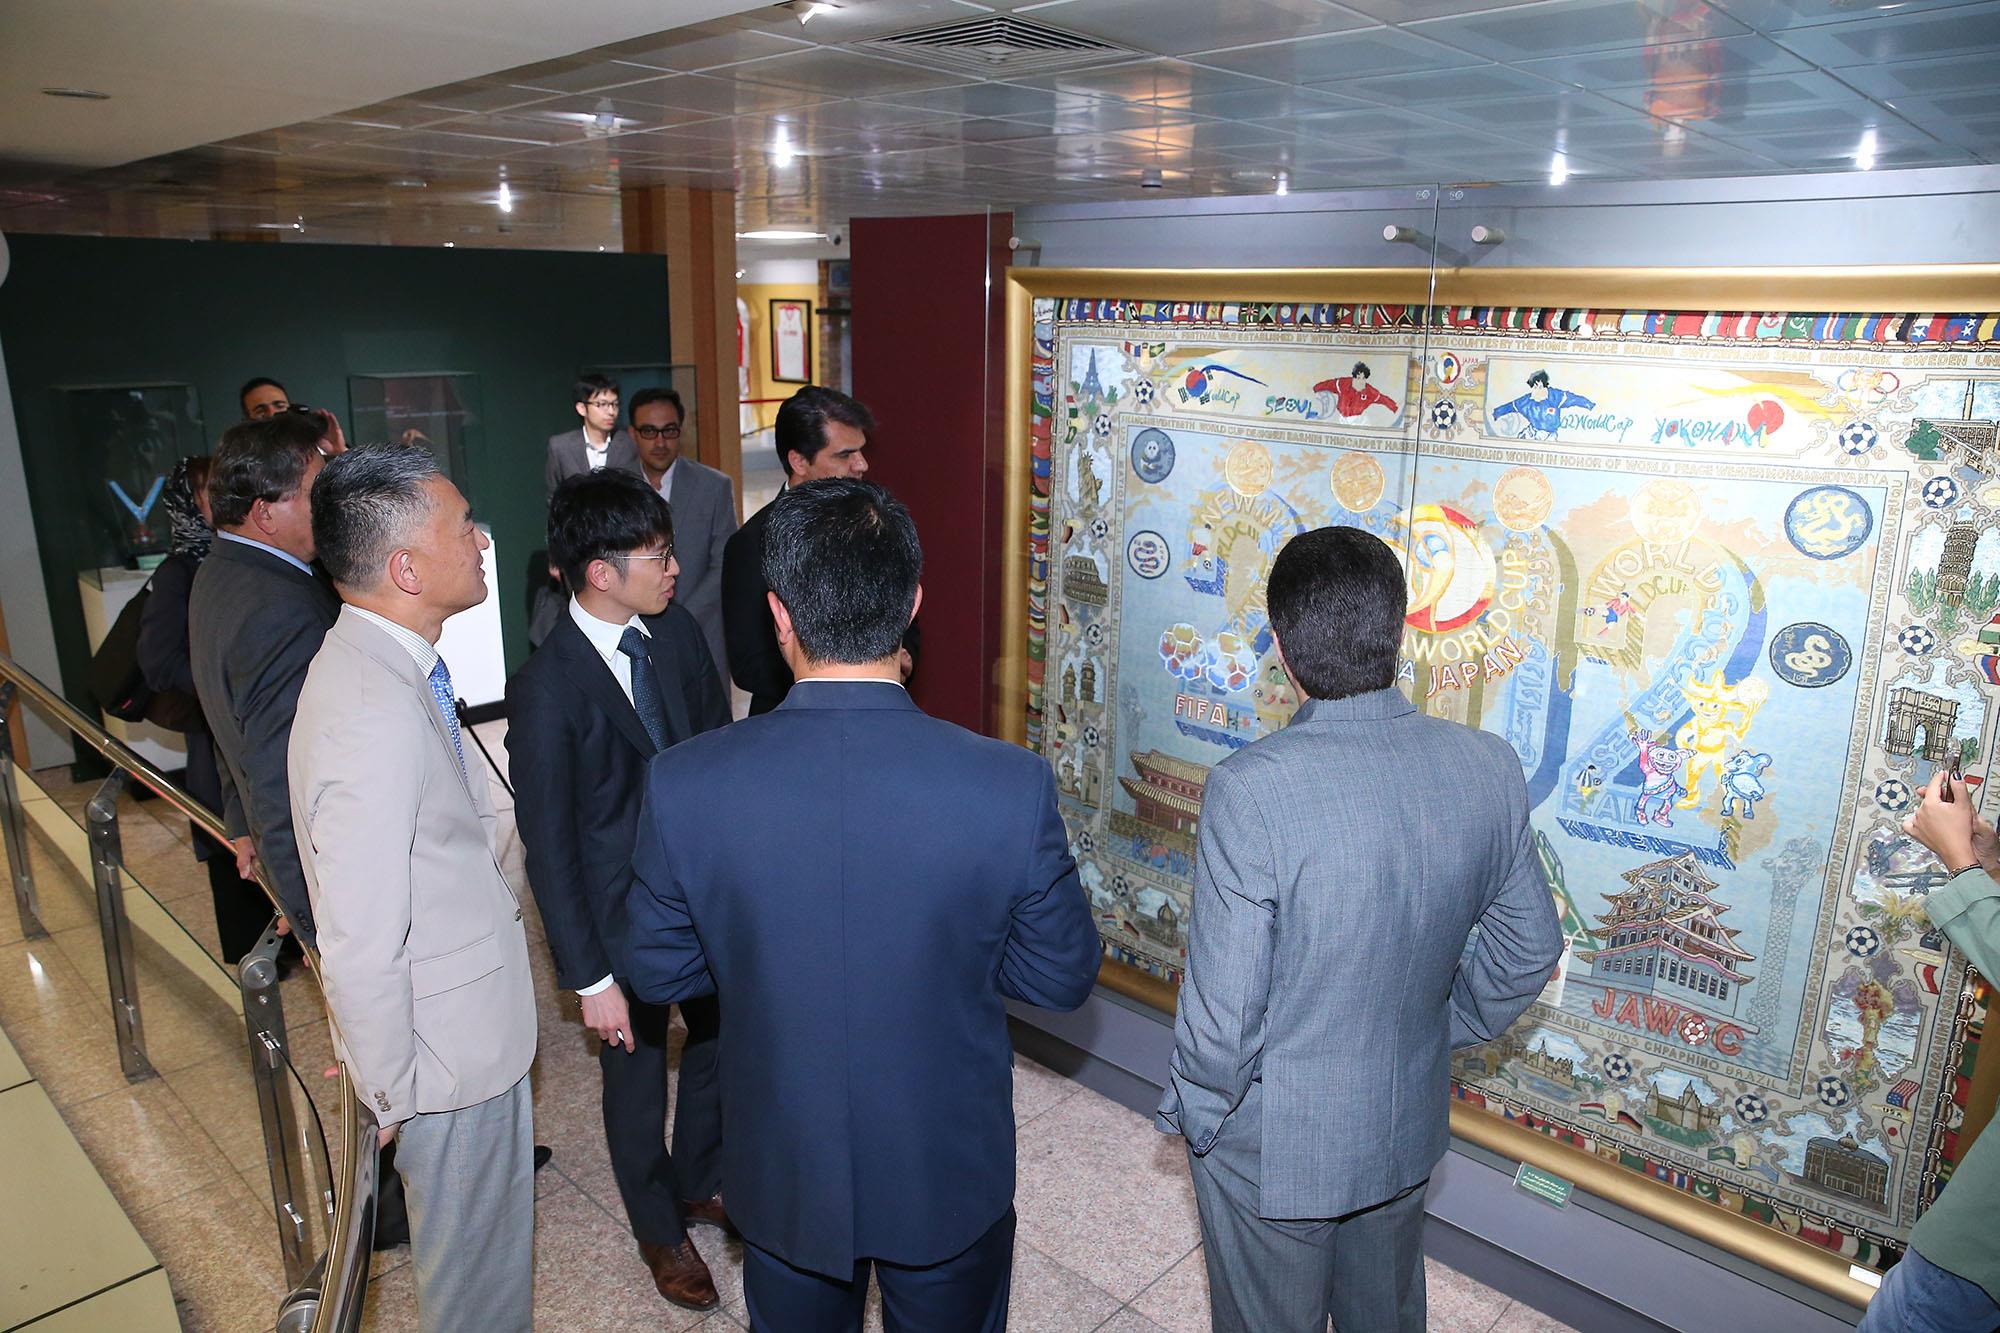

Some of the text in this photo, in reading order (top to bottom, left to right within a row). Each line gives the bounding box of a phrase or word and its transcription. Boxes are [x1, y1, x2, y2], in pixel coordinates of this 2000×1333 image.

[1902, 354, 1968, 366] SWEDEN
[1265, 395, 1319, 420] SEOUL
[1604, 459, 1621, 470] OF
[1425, 636, 1525, 699] JAPAN
[1174, 693, 1229, 729] FIFA
[1591, 987, 1745, 1057] JAWOC
[1596, 1025, 1640, 1047] SWISS
[1777, 1188, 1838, 1217] WORLD
[1841, 1210, 1879, 1231] CUP
